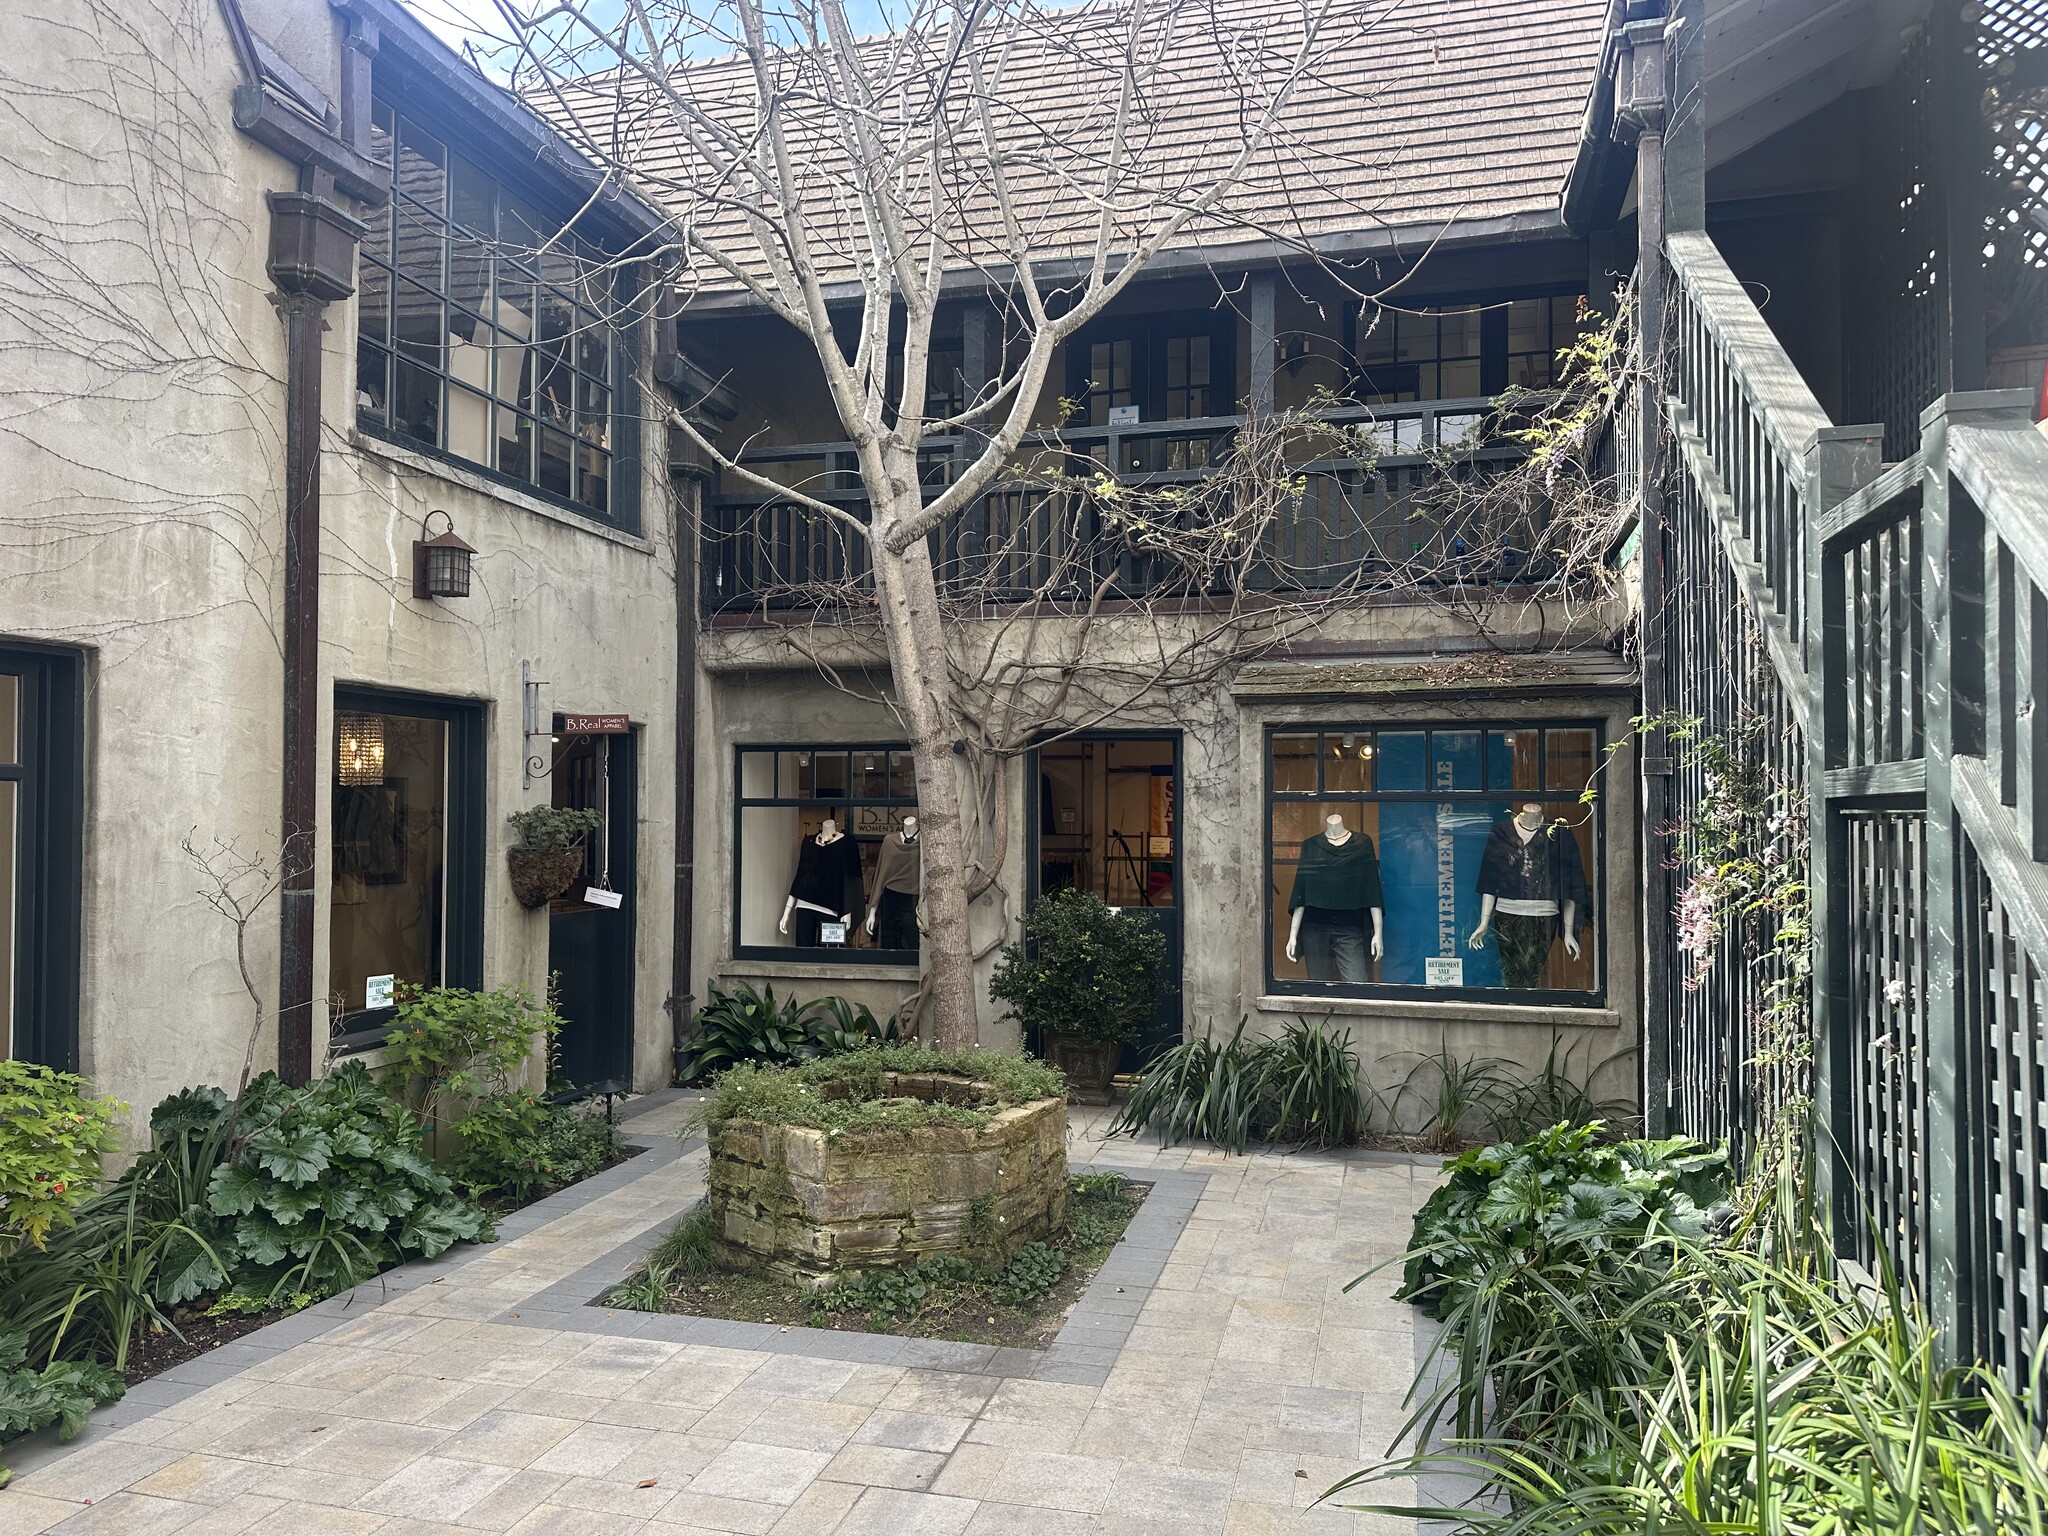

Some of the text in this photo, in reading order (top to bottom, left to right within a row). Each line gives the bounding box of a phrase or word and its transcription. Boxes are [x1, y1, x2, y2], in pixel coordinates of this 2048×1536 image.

[566, 717, 601, 730] B.Real
[1437, 761, 1453, 814] SLE
[1428, 961, 1460, 969] RETIREMENT
